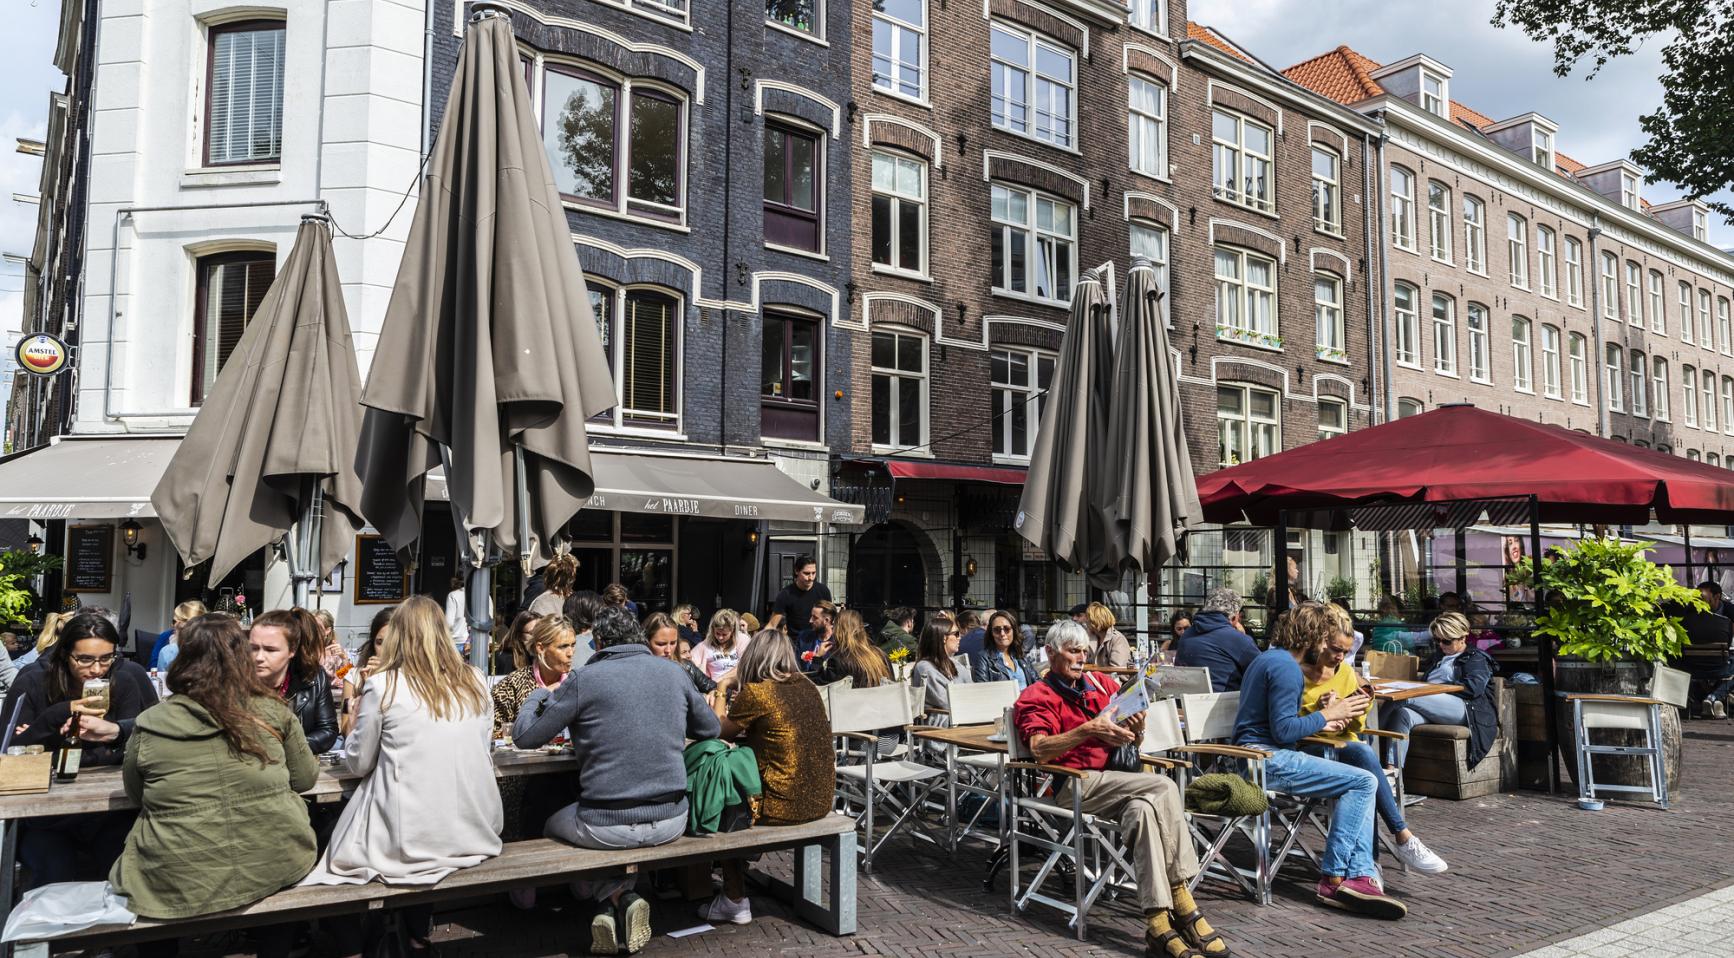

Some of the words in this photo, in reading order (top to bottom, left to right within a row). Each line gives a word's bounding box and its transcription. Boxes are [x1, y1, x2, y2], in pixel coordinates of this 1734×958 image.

[587, 495, 606, 507] NCH
[644, 498, 660, 510] het
[662, 498, 700, 514] PAARDJE
[734, 504, 758, 516] DINER
